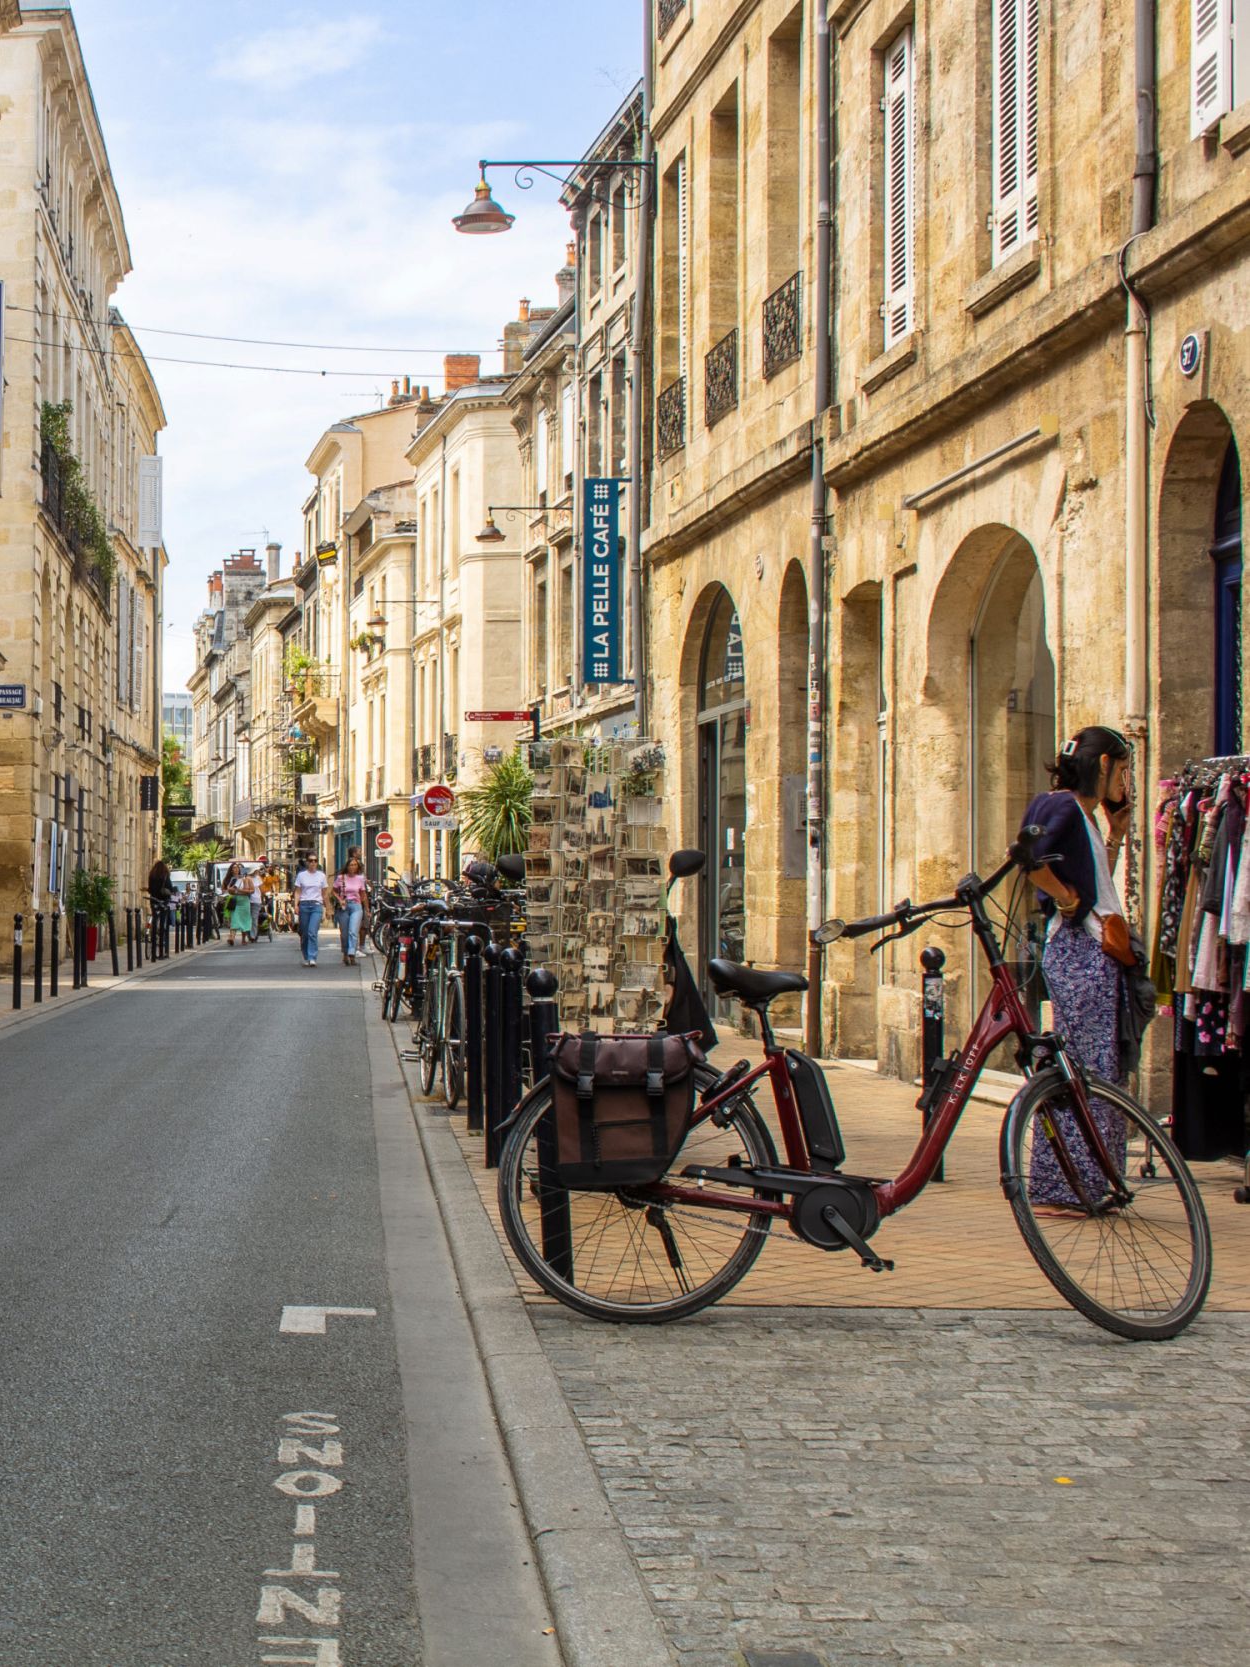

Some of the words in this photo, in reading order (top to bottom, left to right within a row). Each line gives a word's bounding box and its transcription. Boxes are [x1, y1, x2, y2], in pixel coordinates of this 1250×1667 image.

[589, 504, 610, 558] CAFÉ
[592, 564, 610, 626] PELLE
[592, 631, 610, 658] LA
[948, 1043, 980, 1104] KLKOFF
